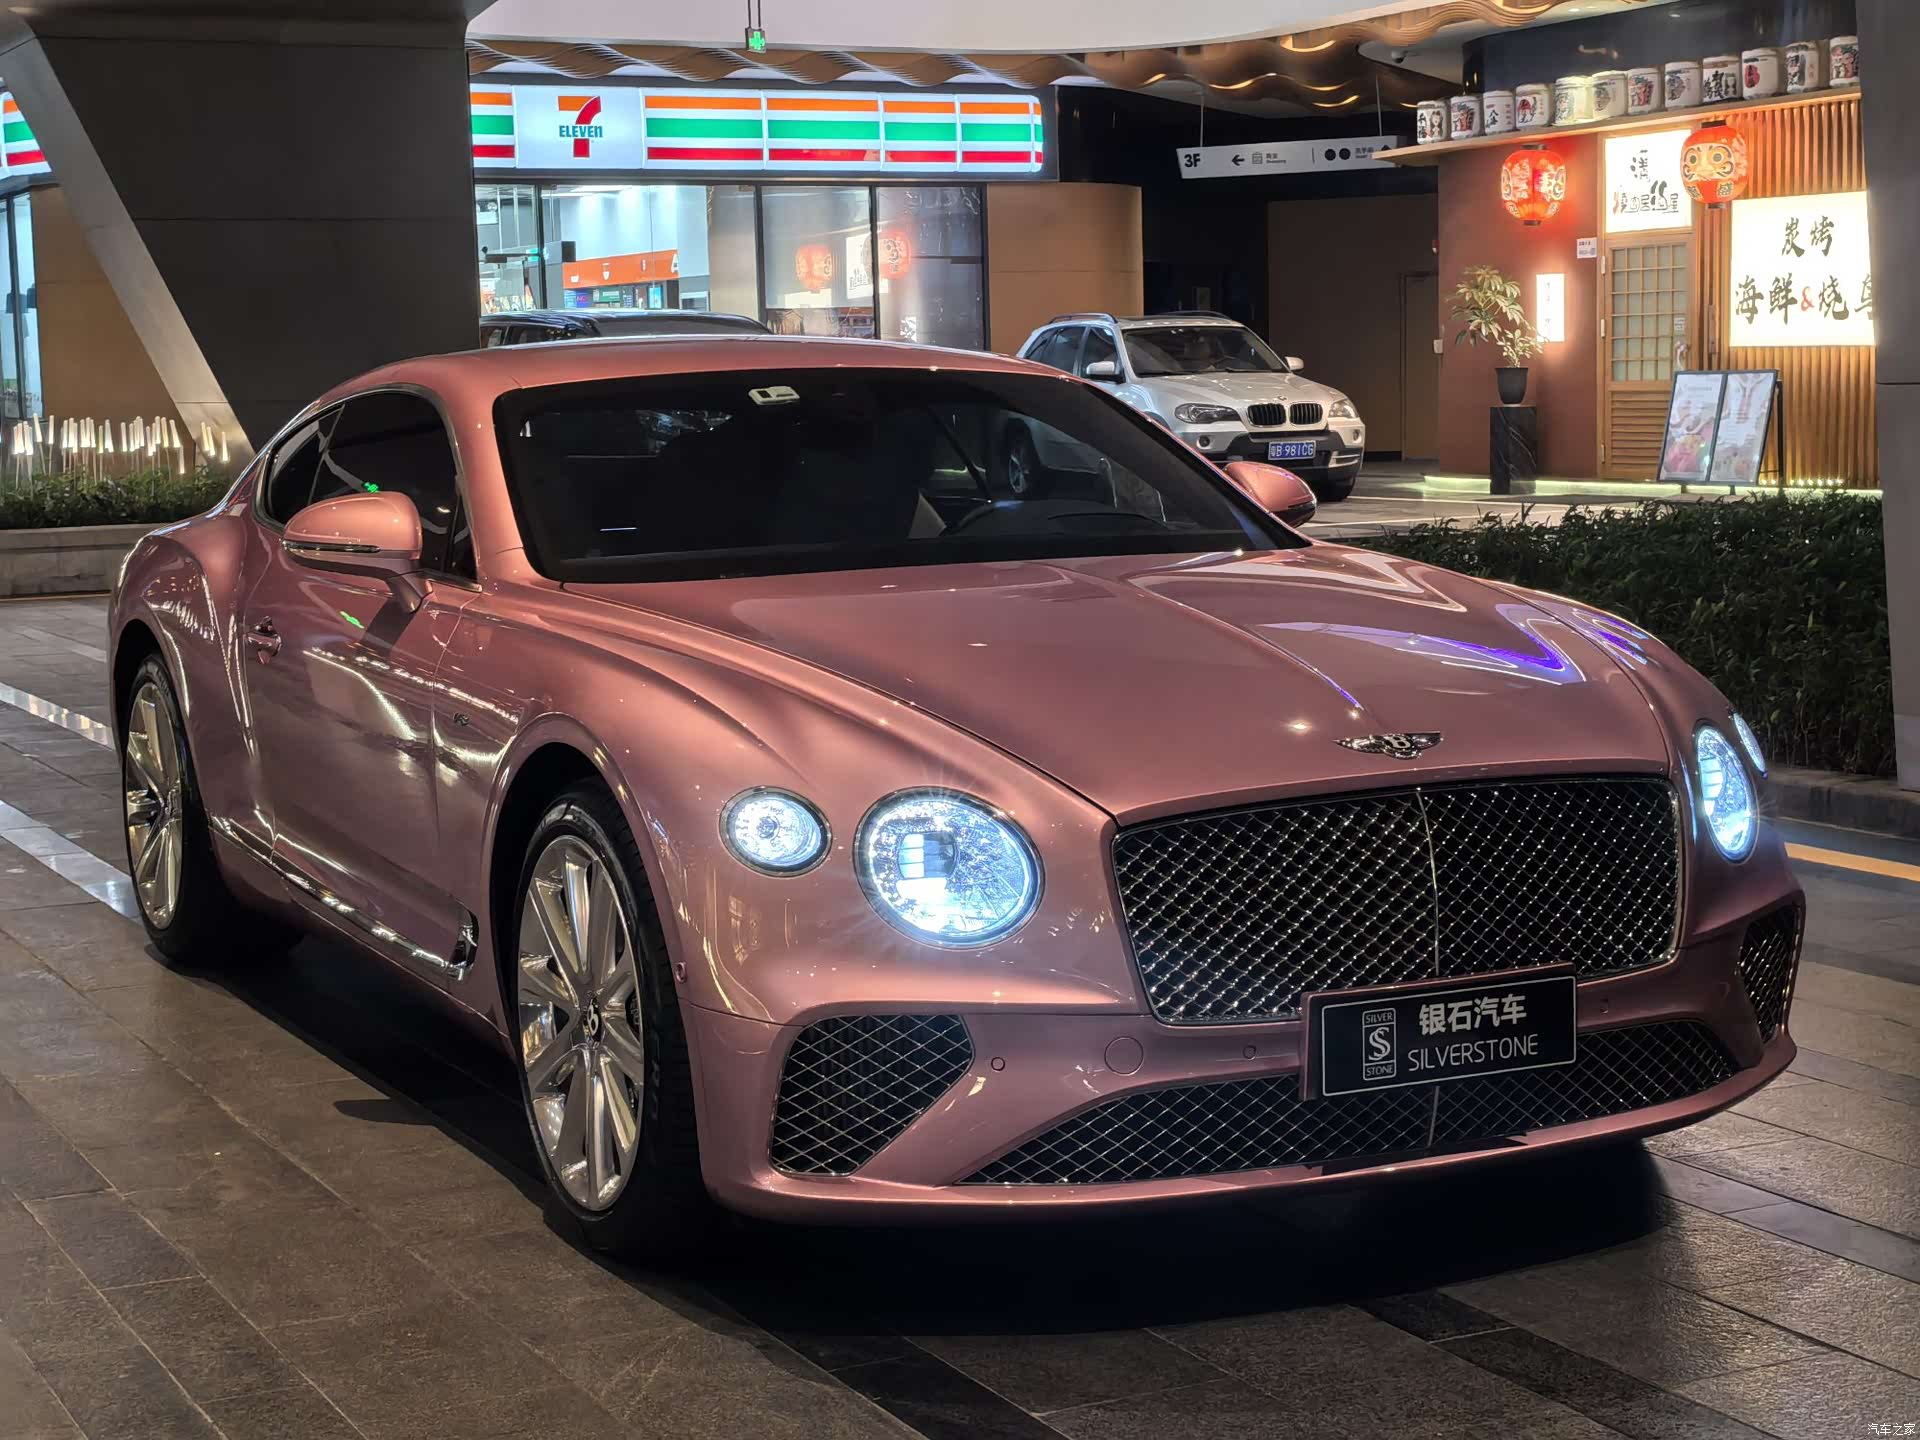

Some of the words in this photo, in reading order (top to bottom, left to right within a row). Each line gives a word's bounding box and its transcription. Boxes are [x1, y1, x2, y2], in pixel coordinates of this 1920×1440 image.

[1184, 153, 1201, 168] 3F
[1781, 215, 1835, 258] 炭烤
[1365, 1012, 1393, 1024] SILVER
[1419, 993, 1527, 1036] 银石汽车
[1408, 1033, 1538, 1072] SILVERSTONE
[1366, 1064, 1393, 1077] STONE
